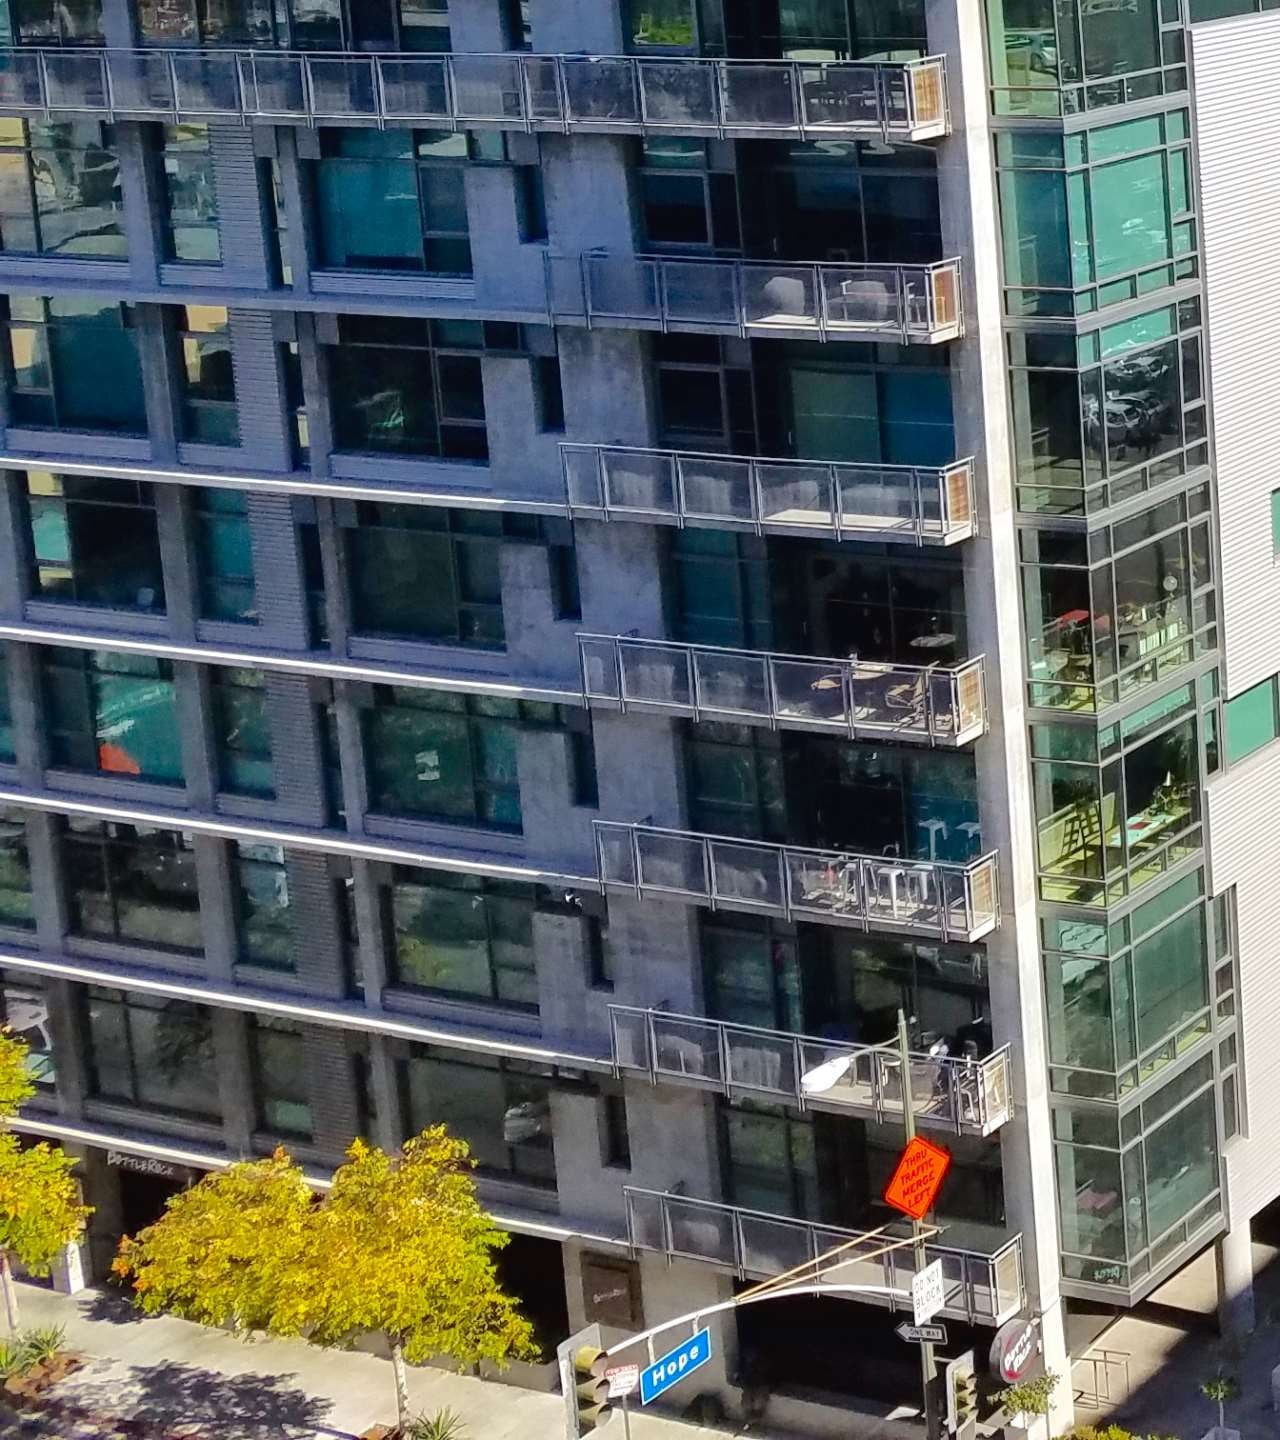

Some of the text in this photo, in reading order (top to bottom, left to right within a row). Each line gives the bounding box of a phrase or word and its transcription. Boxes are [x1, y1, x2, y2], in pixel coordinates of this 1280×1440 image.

[901, 1158, 934, 1185] TRAFFIC
[905, 1148, 928, 1168] THRU
[902, 1171, 935, 1198] MERGE
[908, 1186, 931, 1208] LEFT
[652, 1345, 699, 1386] Hope
